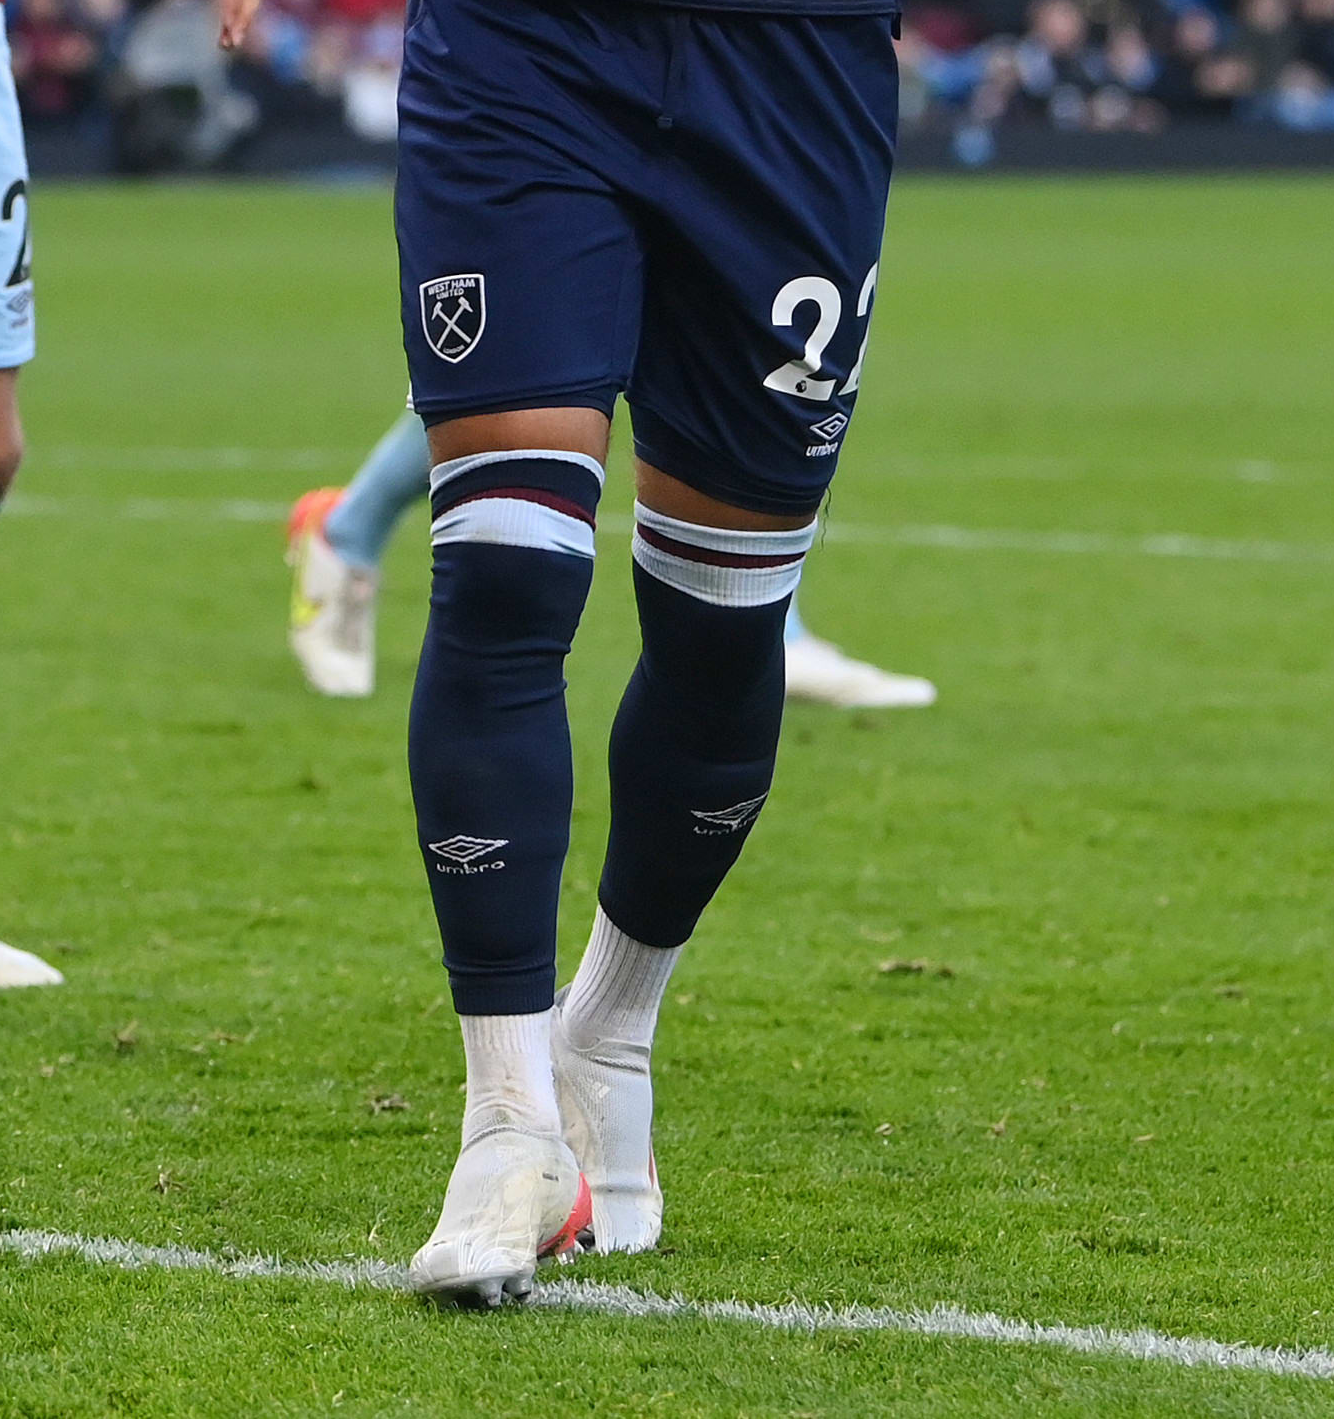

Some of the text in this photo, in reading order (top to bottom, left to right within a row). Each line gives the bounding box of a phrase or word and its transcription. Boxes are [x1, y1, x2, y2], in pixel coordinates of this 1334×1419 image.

[427, 278, 476, 295] WEST HAM
[436, 861, 506, 874] umbro
